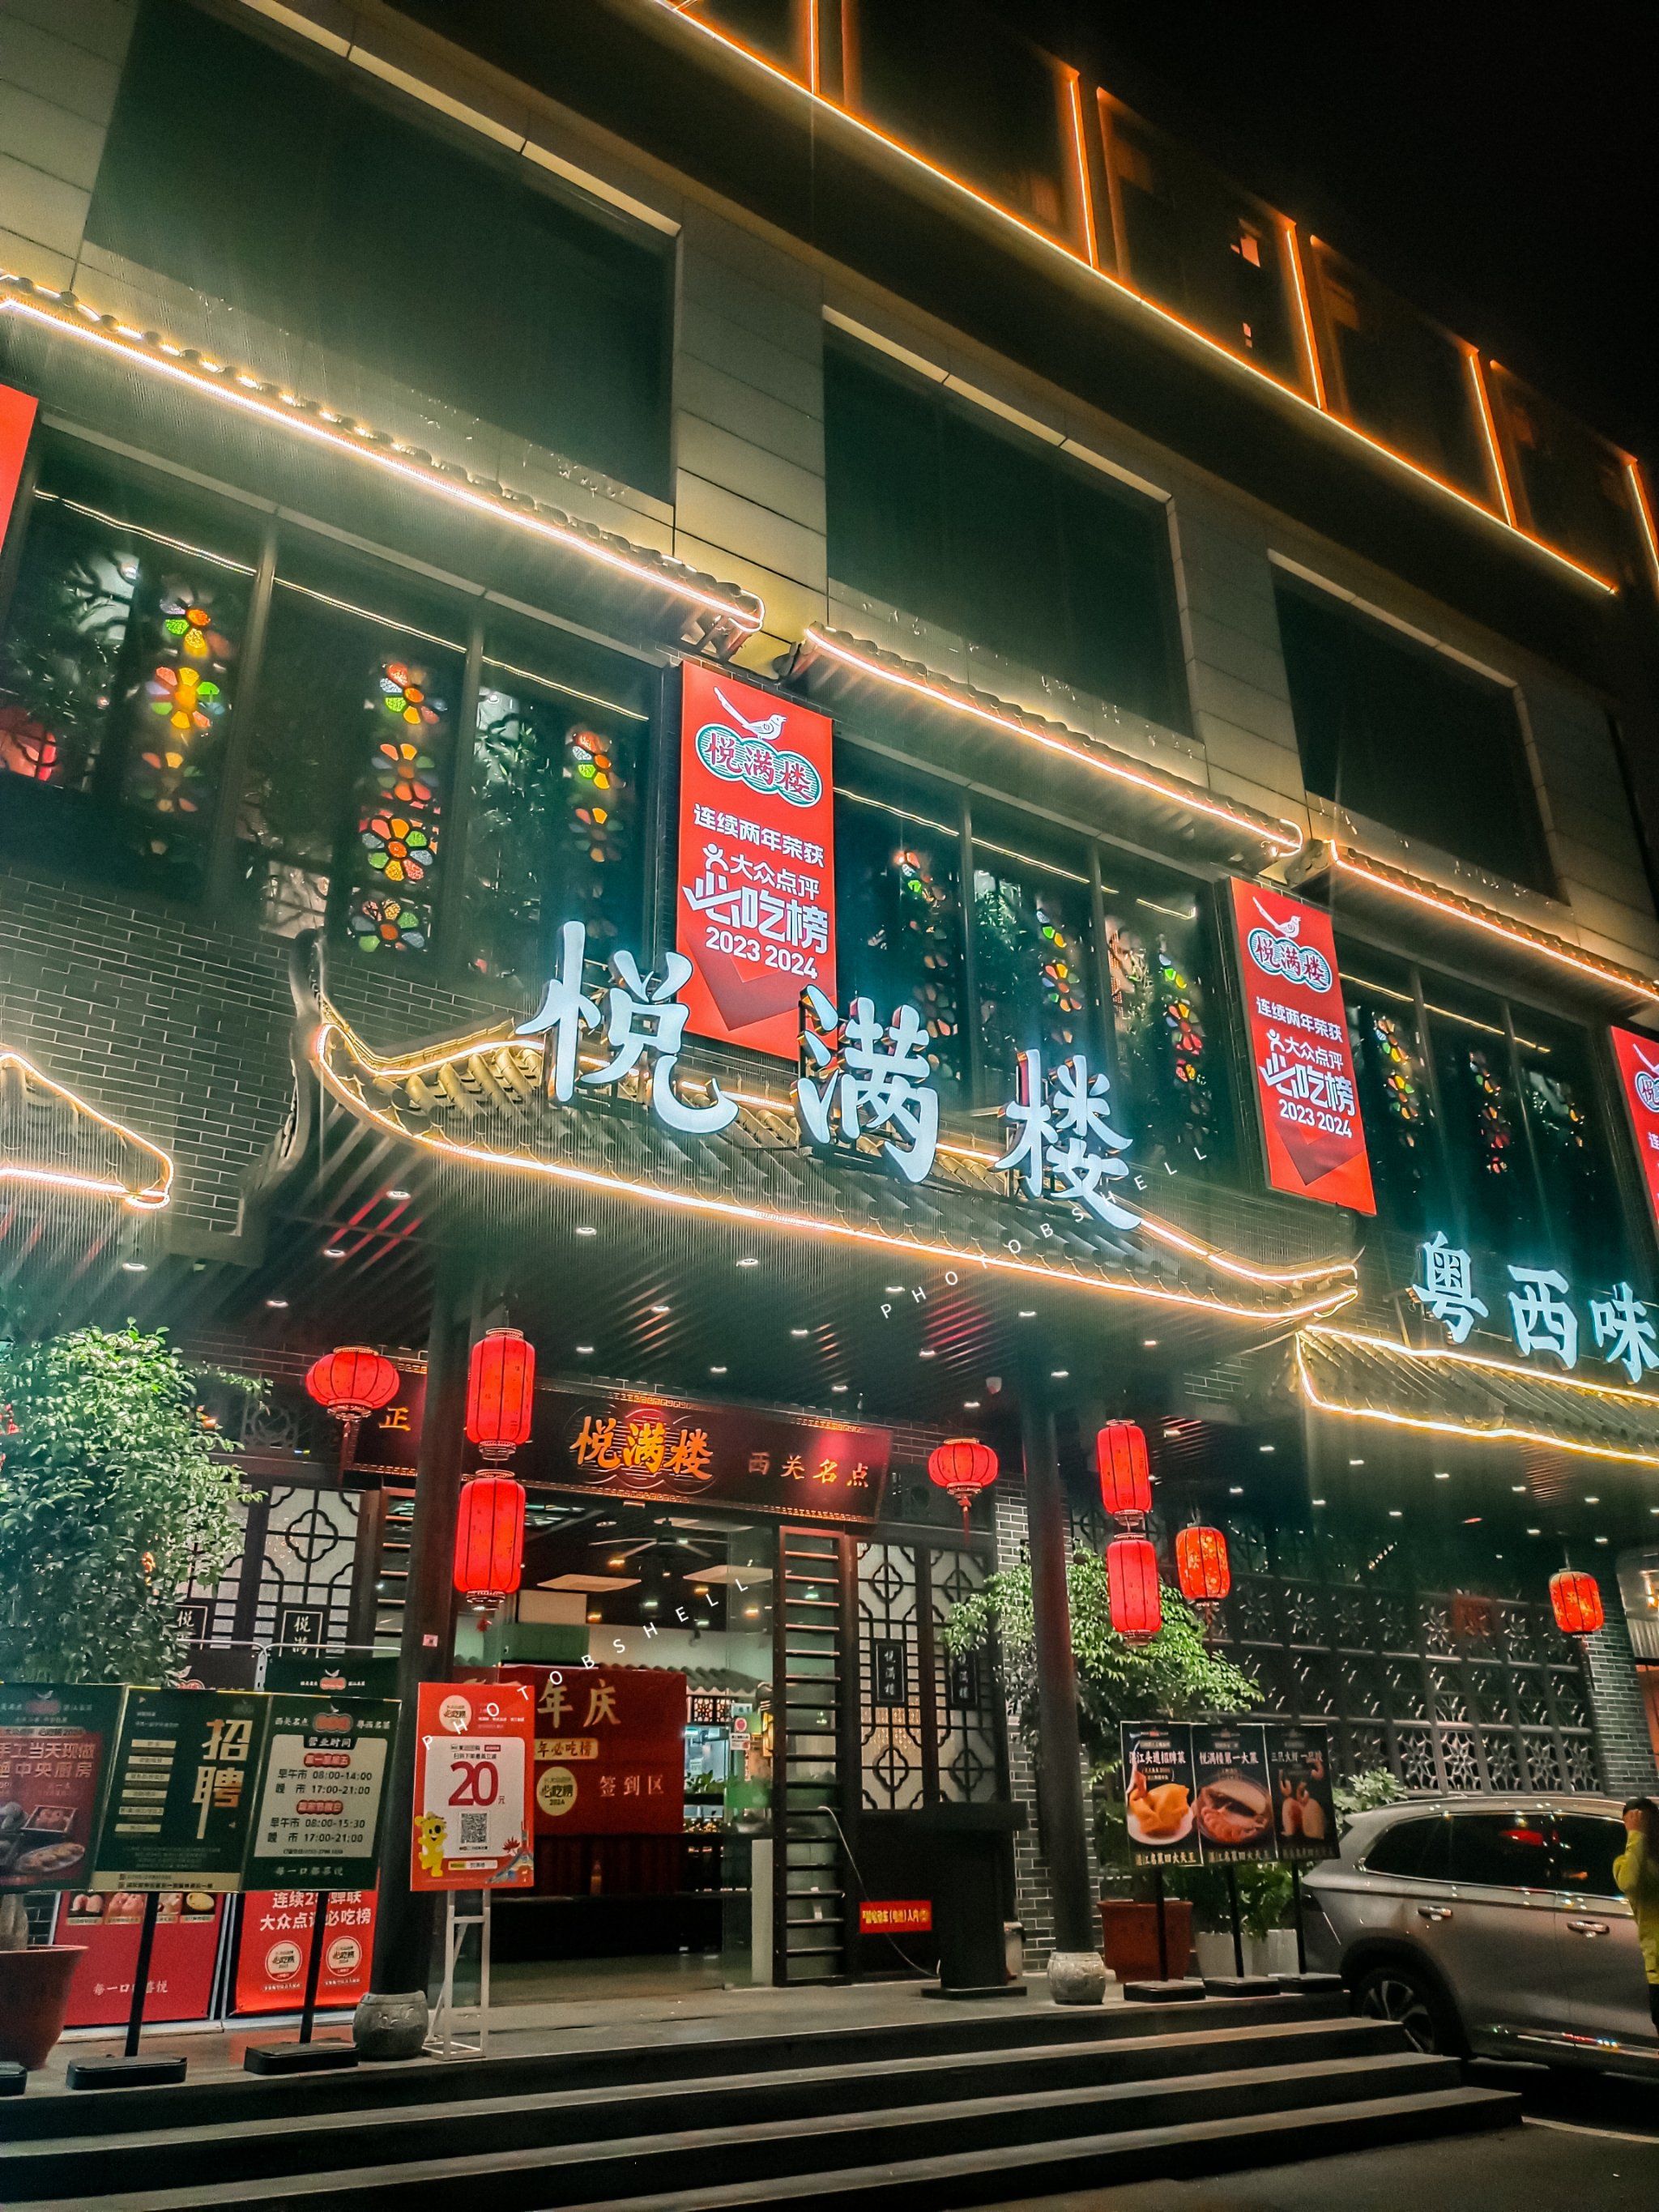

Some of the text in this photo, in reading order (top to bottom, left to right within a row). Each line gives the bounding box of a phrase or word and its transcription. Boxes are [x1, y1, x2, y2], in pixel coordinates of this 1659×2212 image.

[705, 731, 814, 803] 悦满楼
[693, 803, 825, 868] 连续两年荣获
[730, 854, 821, 901] 大众点评
[682, 870, 830, 955] 必吃榜
[705, 927, 818, 980] 2023 2024
[1255, 934, 1328, 988] 悦满楼
[1256, 996, 1344, 1043] 连续两年荣获
[515, 920, 1142, 1230] 悦满楼
[1284, 1035, 1344, 1072] 大众点评
[1258, 1052, 1356, 1117] 必吃榜
[1278, 1097, 1353, 1139] 2023 2024
[1412, 1230, 1659, 1384] 粤西味
[378, 1407, 412, 1431] 正
[569, 1413, 714, 1481] 悦满楼
[748, 1451, 871, 1489] 西关名点
[308, 1736, 352, 1748] 营业时间
[191, 1719, 254, 1839] 招聘
[278, 1769, 373, 1781] 早午市 08:00-14:00
[312, 1784, 370, 1795] 17:00-21:00
[448, 1761, 499, 1806] 20
[599, 1775, 664, 1797] 签到区
[270, 1817, 365, 1829] 早午市 08:00-15:30
[304, 1833, 363, 1843] 17:00-21:00
[272, 1891, 361, 1909] 连续2蝉联
[93, 1980, 168, 1996] 每一口喜悦
